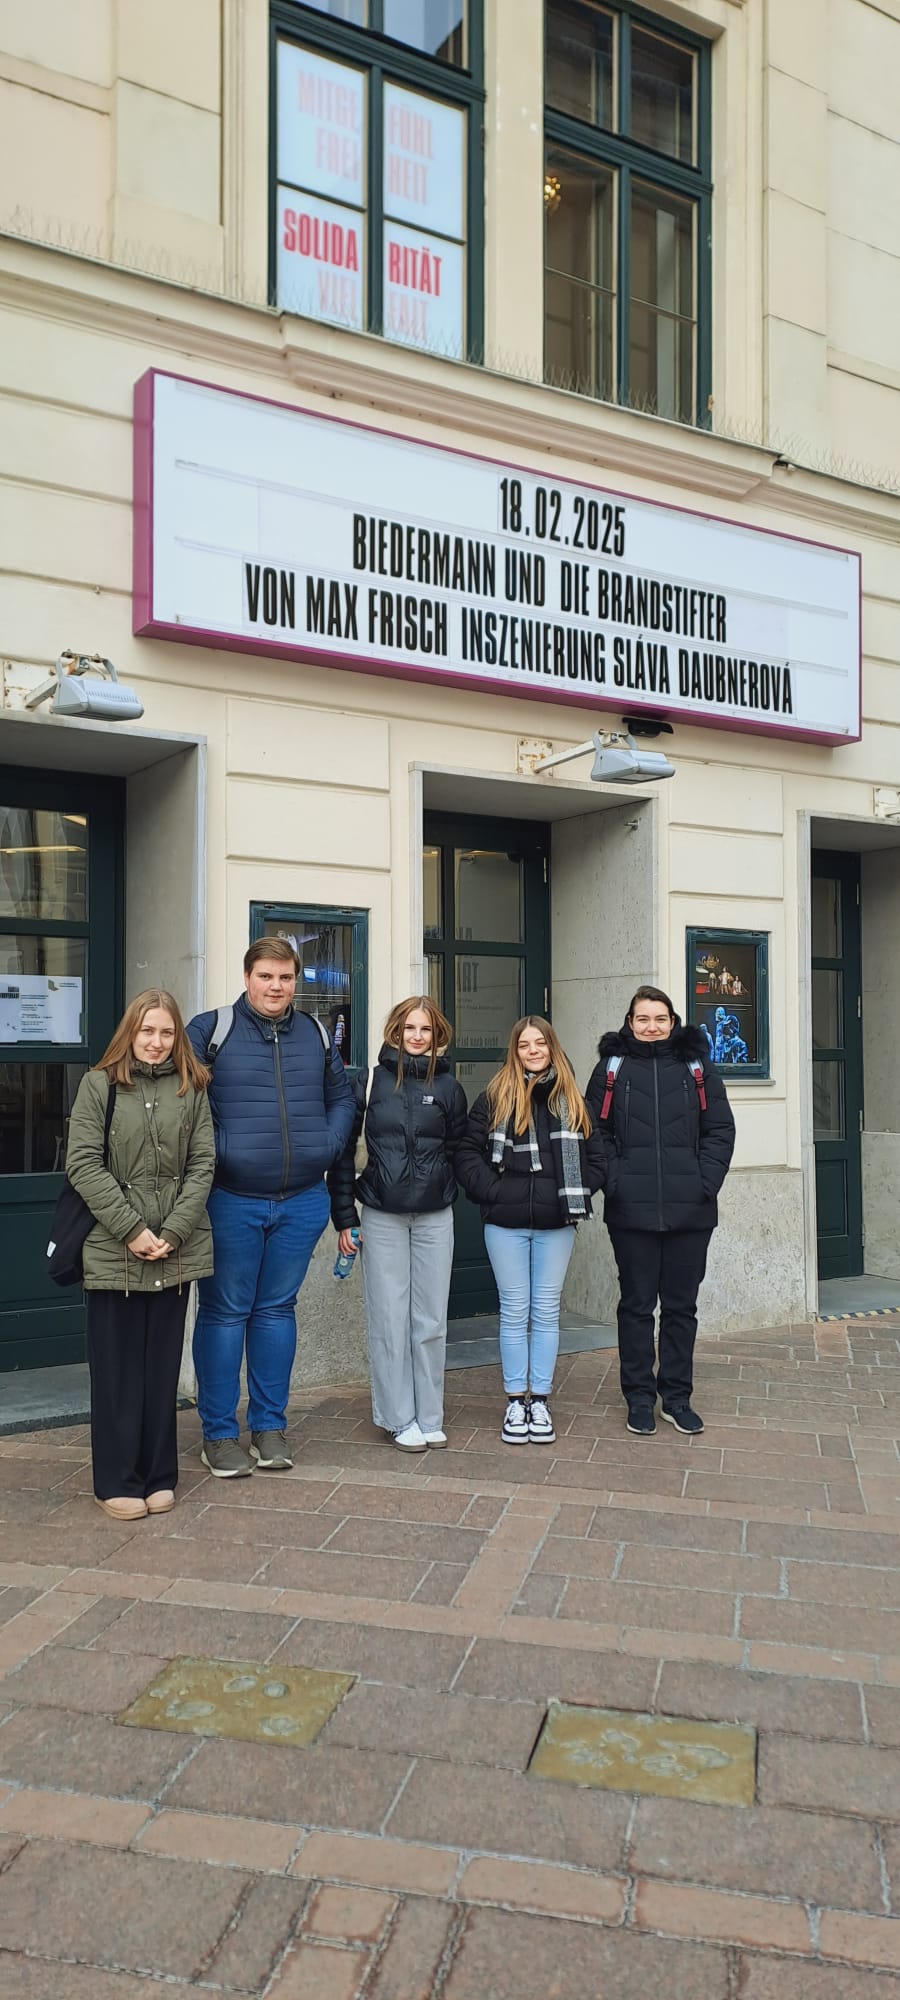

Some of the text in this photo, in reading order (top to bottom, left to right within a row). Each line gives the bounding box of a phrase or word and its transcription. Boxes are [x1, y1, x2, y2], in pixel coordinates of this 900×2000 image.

[283, 207, 442, 297] SOLIDA RITÄT
[500, 477, 626, 557] 18.02.2025
[353, 513, 727, 644] BIEDERMANN UND DIE BRANDSTIFTER
[245, 562, 793, 714] VON MAX FRISCH INSZENIERUNG SLÁVA DAUBNEROVÁ
